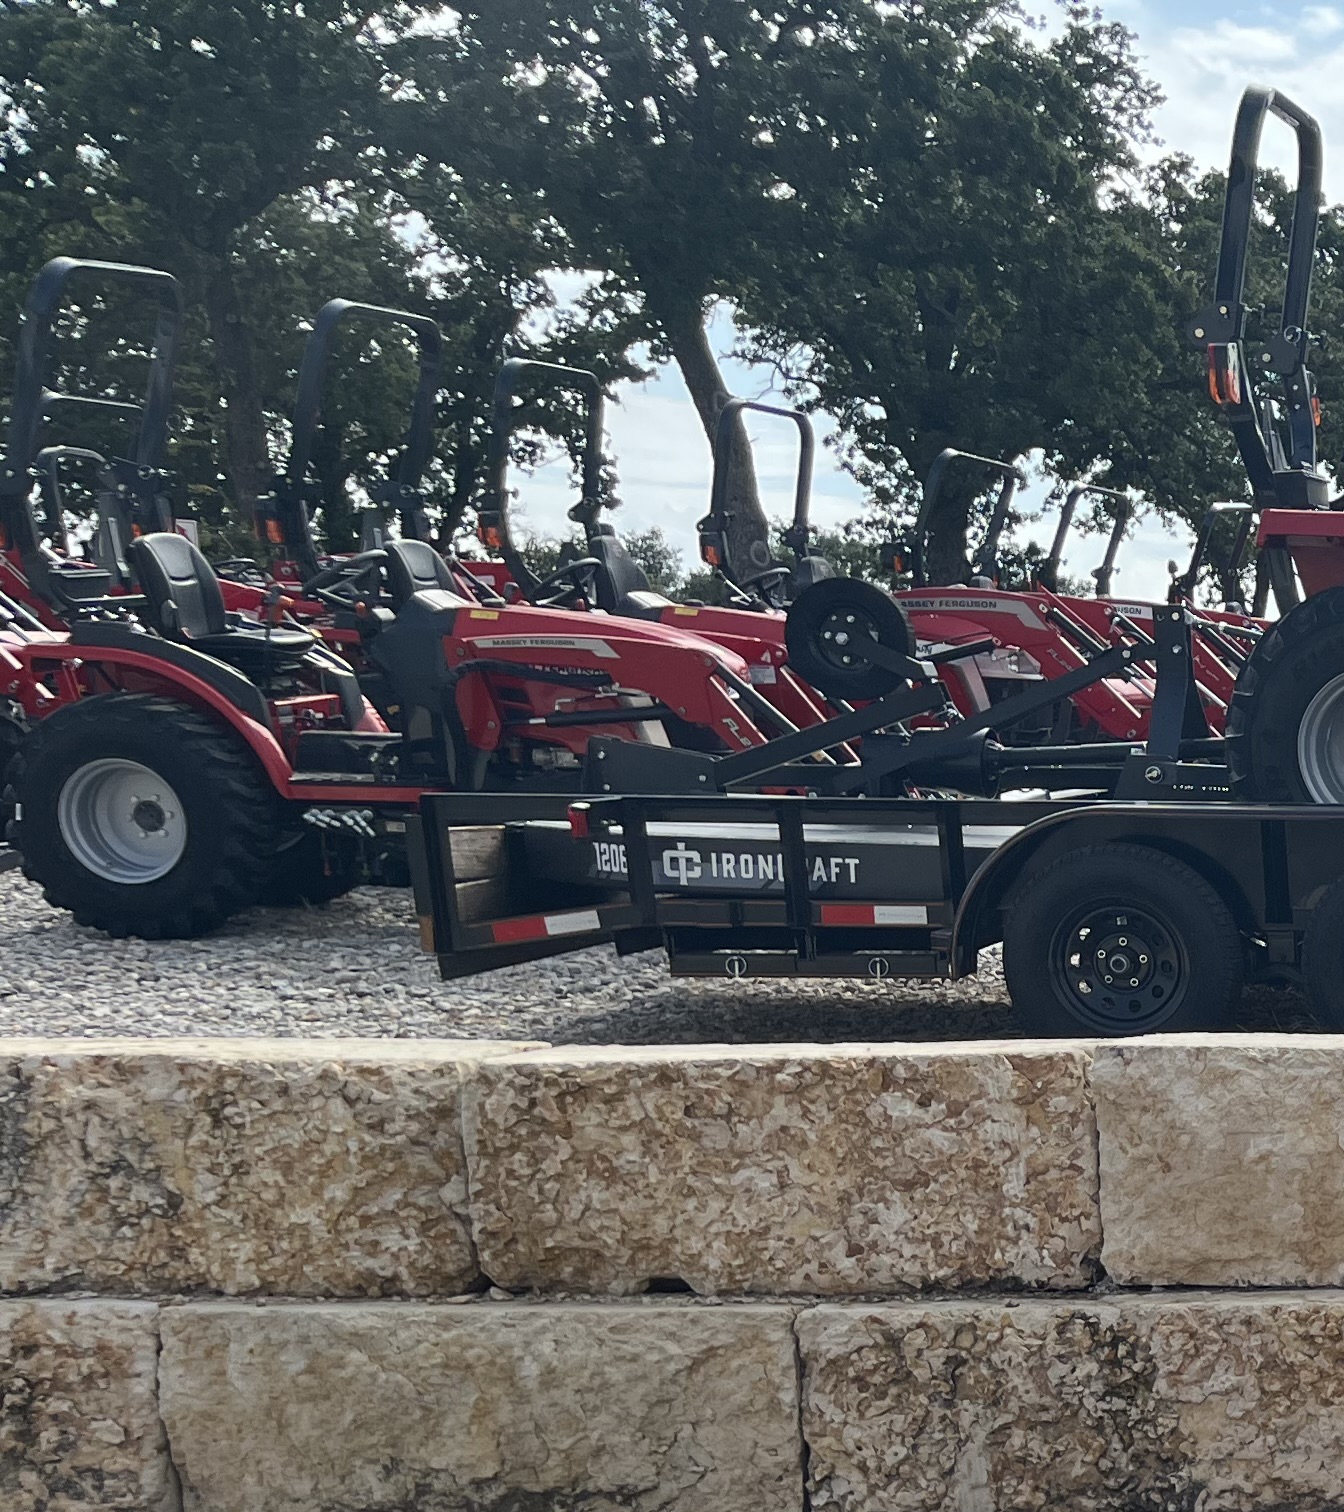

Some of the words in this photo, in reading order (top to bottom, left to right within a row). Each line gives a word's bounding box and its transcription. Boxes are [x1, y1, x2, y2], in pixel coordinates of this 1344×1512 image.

[939, 600, 997, 609] FERGUSON
[492, 639, 527, 647] MASSEY
[529, 639, 576, 647] FERGUSON
[710, 852, 860, 884] IRONAFT
